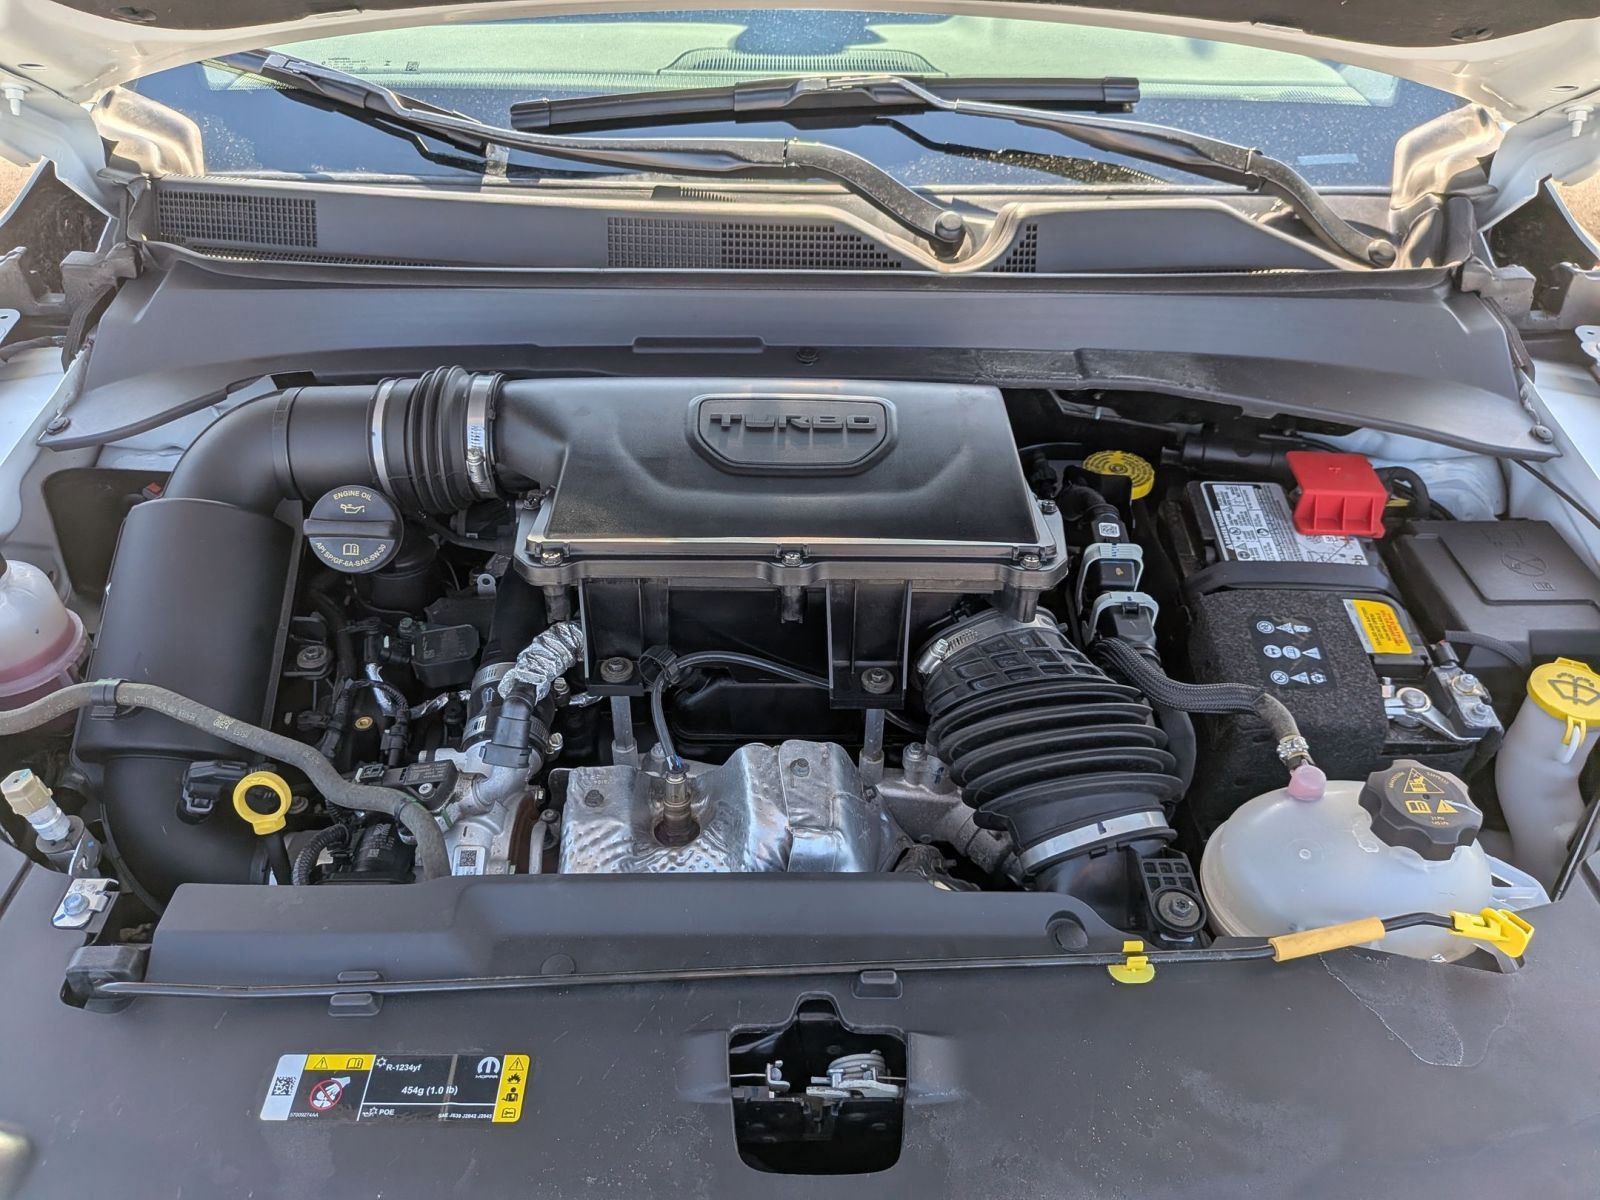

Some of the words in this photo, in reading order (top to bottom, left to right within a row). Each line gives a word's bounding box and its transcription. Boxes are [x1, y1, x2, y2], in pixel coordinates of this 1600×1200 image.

[710, 413, 877, 431] TURBO
[333, 490, 360, 500] ENGINE
[361, 492, 372, 502] OIL
[315, 542, 325, 554] API
[385, 1063, 422, 1073] R-1234yf
[401, 1086, 424, 1097] 454g
[426, 1086, 444, 1097] (1.0
[446, 1085, 458, 1096] lb)
[379, 1108, 395, 1116] POE
